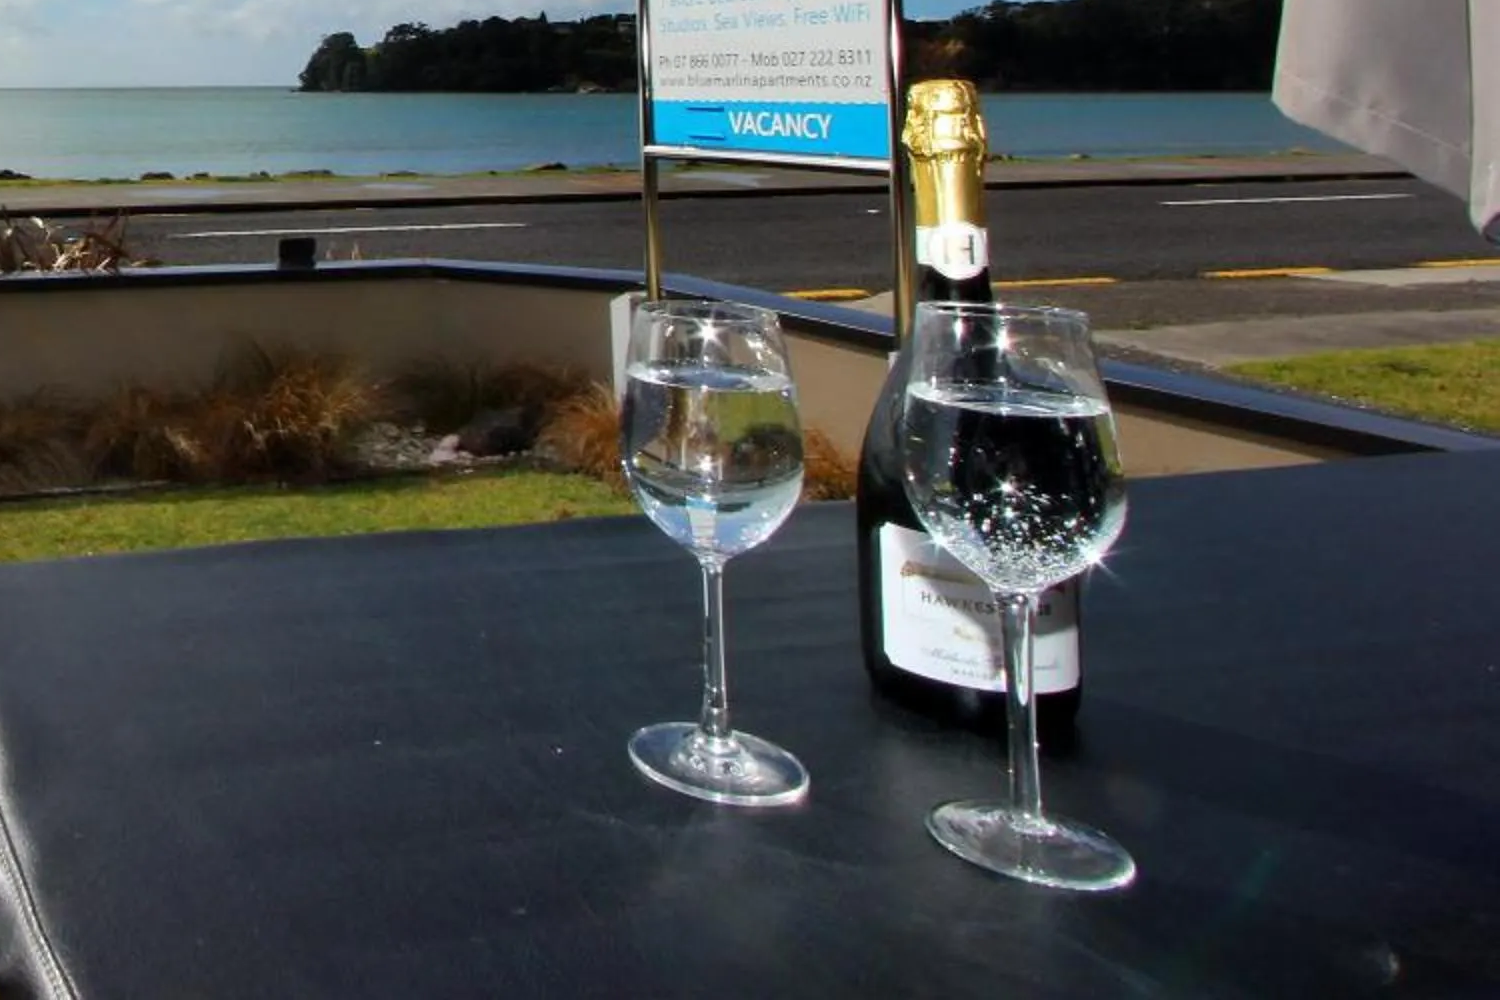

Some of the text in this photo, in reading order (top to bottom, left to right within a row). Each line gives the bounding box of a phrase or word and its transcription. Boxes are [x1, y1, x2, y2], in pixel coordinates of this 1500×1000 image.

[713, 12, 738, 31] Sea
[794, 6, 829, 25] Free
[834, 2, 870, 23] WiFi
[712, 53, 739, 69] 0077
[751, 51, 779, 67] Mob
[782, 51, 805, 67] 027
[810, 49, 834, 67] 222
[839, 49, 871, 65] 8311
[728, 111, 832, 140] VACANCY
